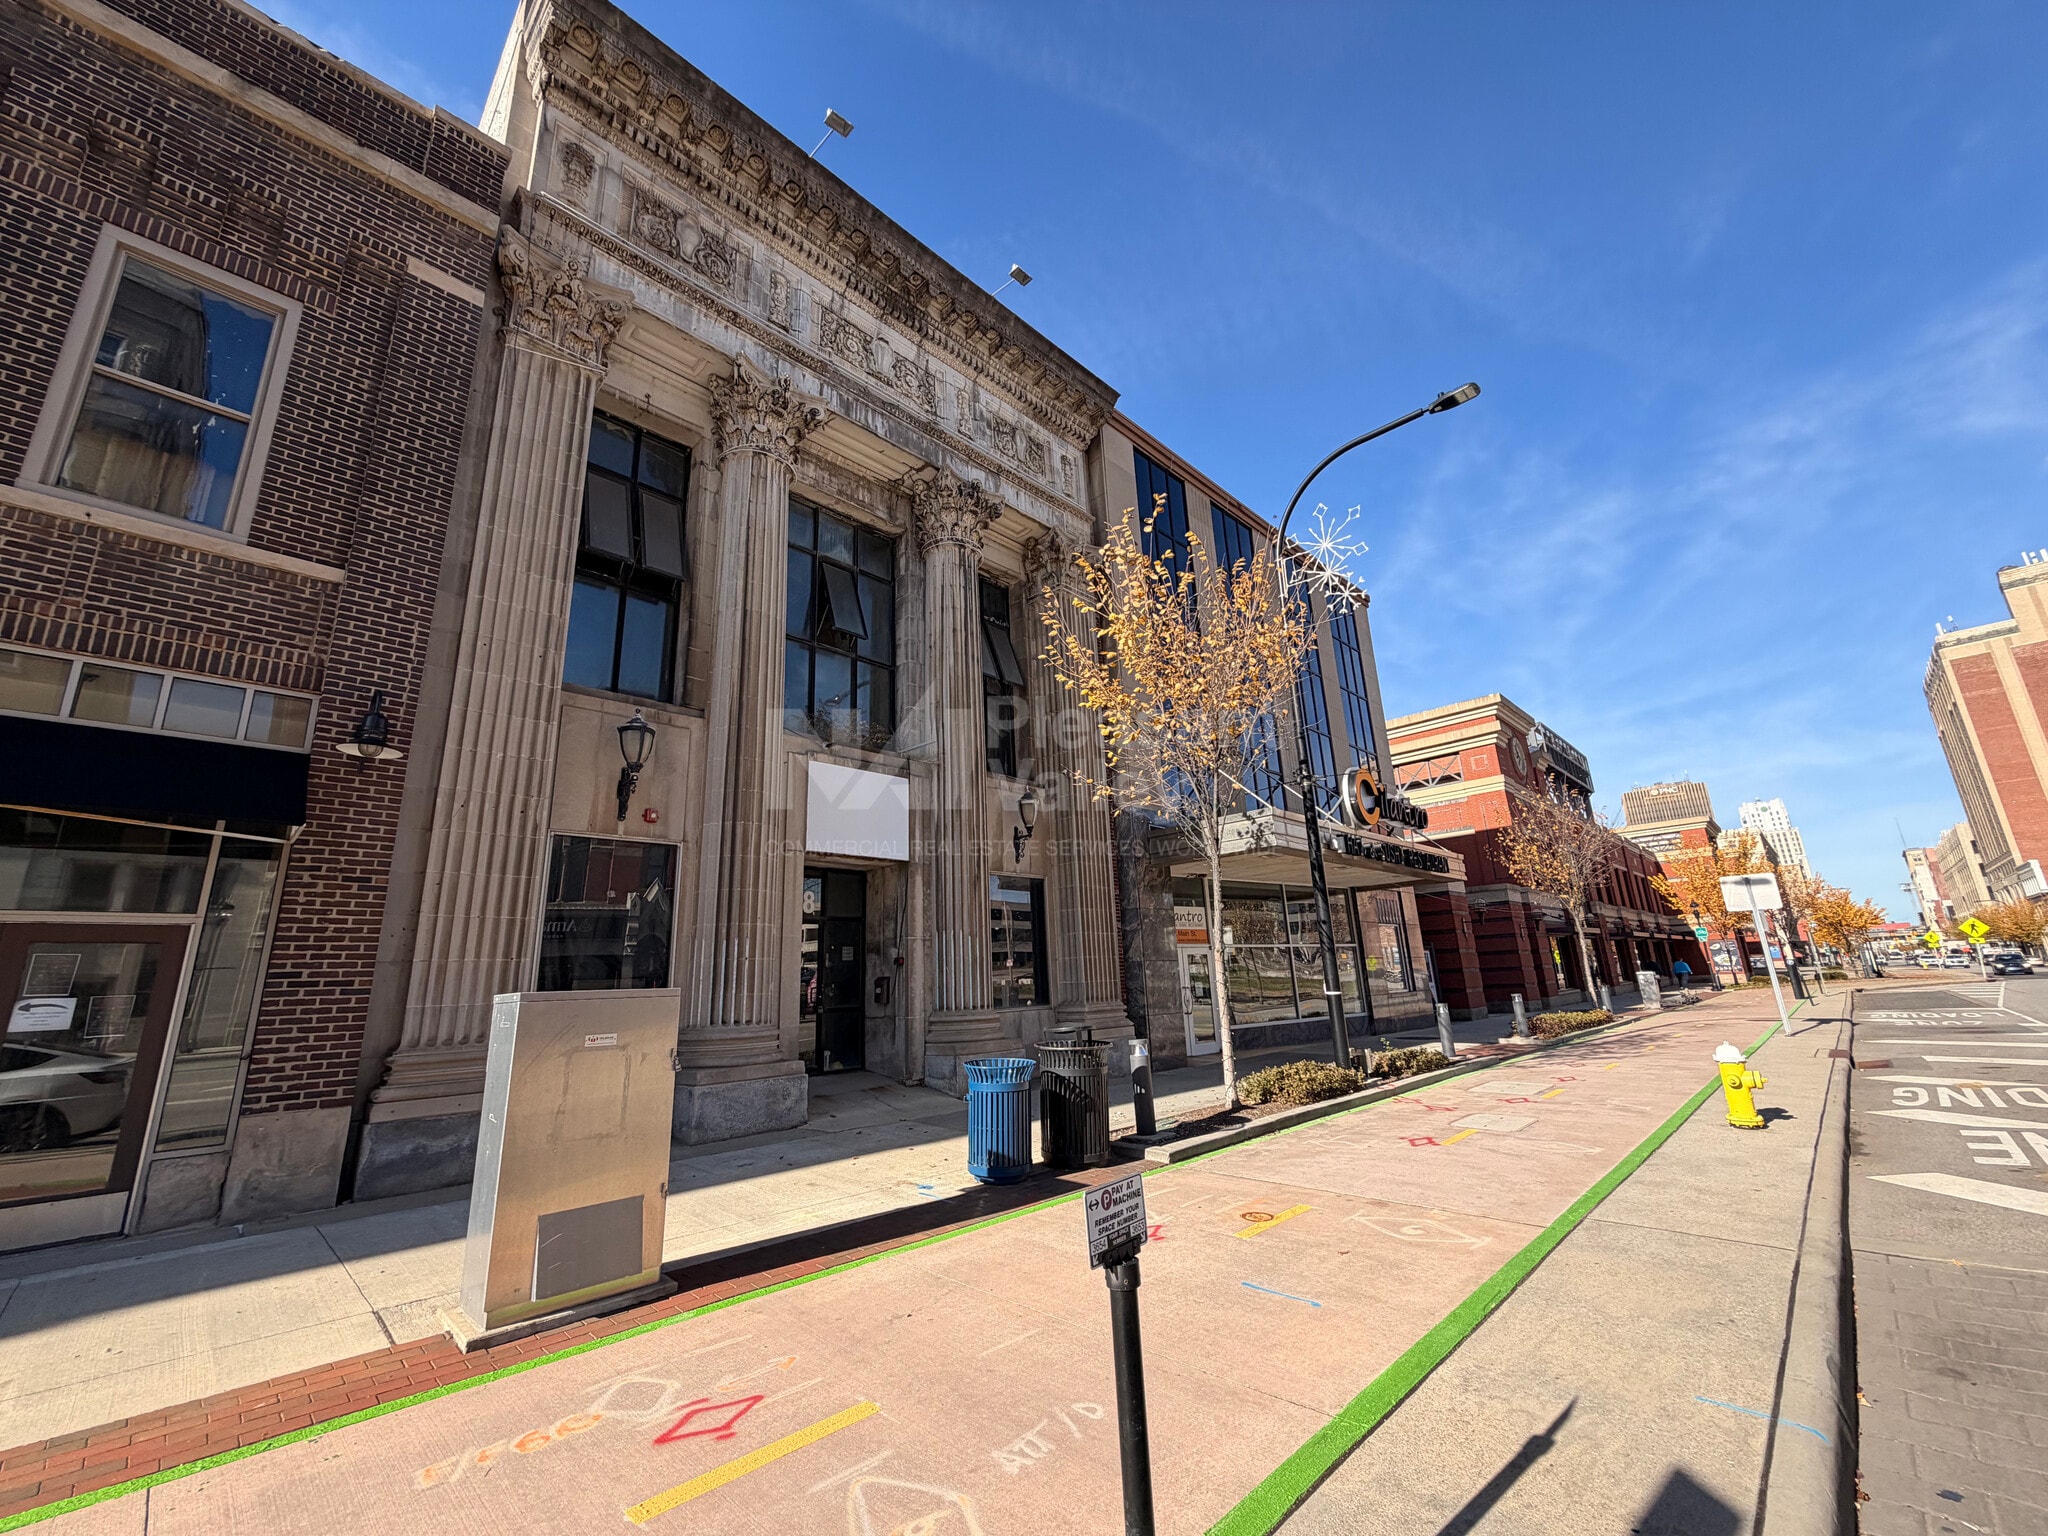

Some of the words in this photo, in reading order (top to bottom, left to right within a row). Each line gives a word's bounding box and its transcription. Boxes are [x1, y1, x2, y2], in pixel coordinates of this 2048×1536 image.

[1350, 768, 1428, 829] Cilantro
[1658, 786, 1679, 796] PNC
[1869, 1011, 2005, 1019] LOADING
[1111, 1183, 1124, 1197] PAY
[1126, 1180, 1134, 1190] AT
[1112, 1188, 1142, 1207] MACHINE
[1094, 1209, 1125, 1228] REMEMBER
[1125, 1202, 1140, 1215] YOUR
[1097, 1222, 1116, 1236] SPACE
[1116, 1213, 1139, 1229] NUMBER
